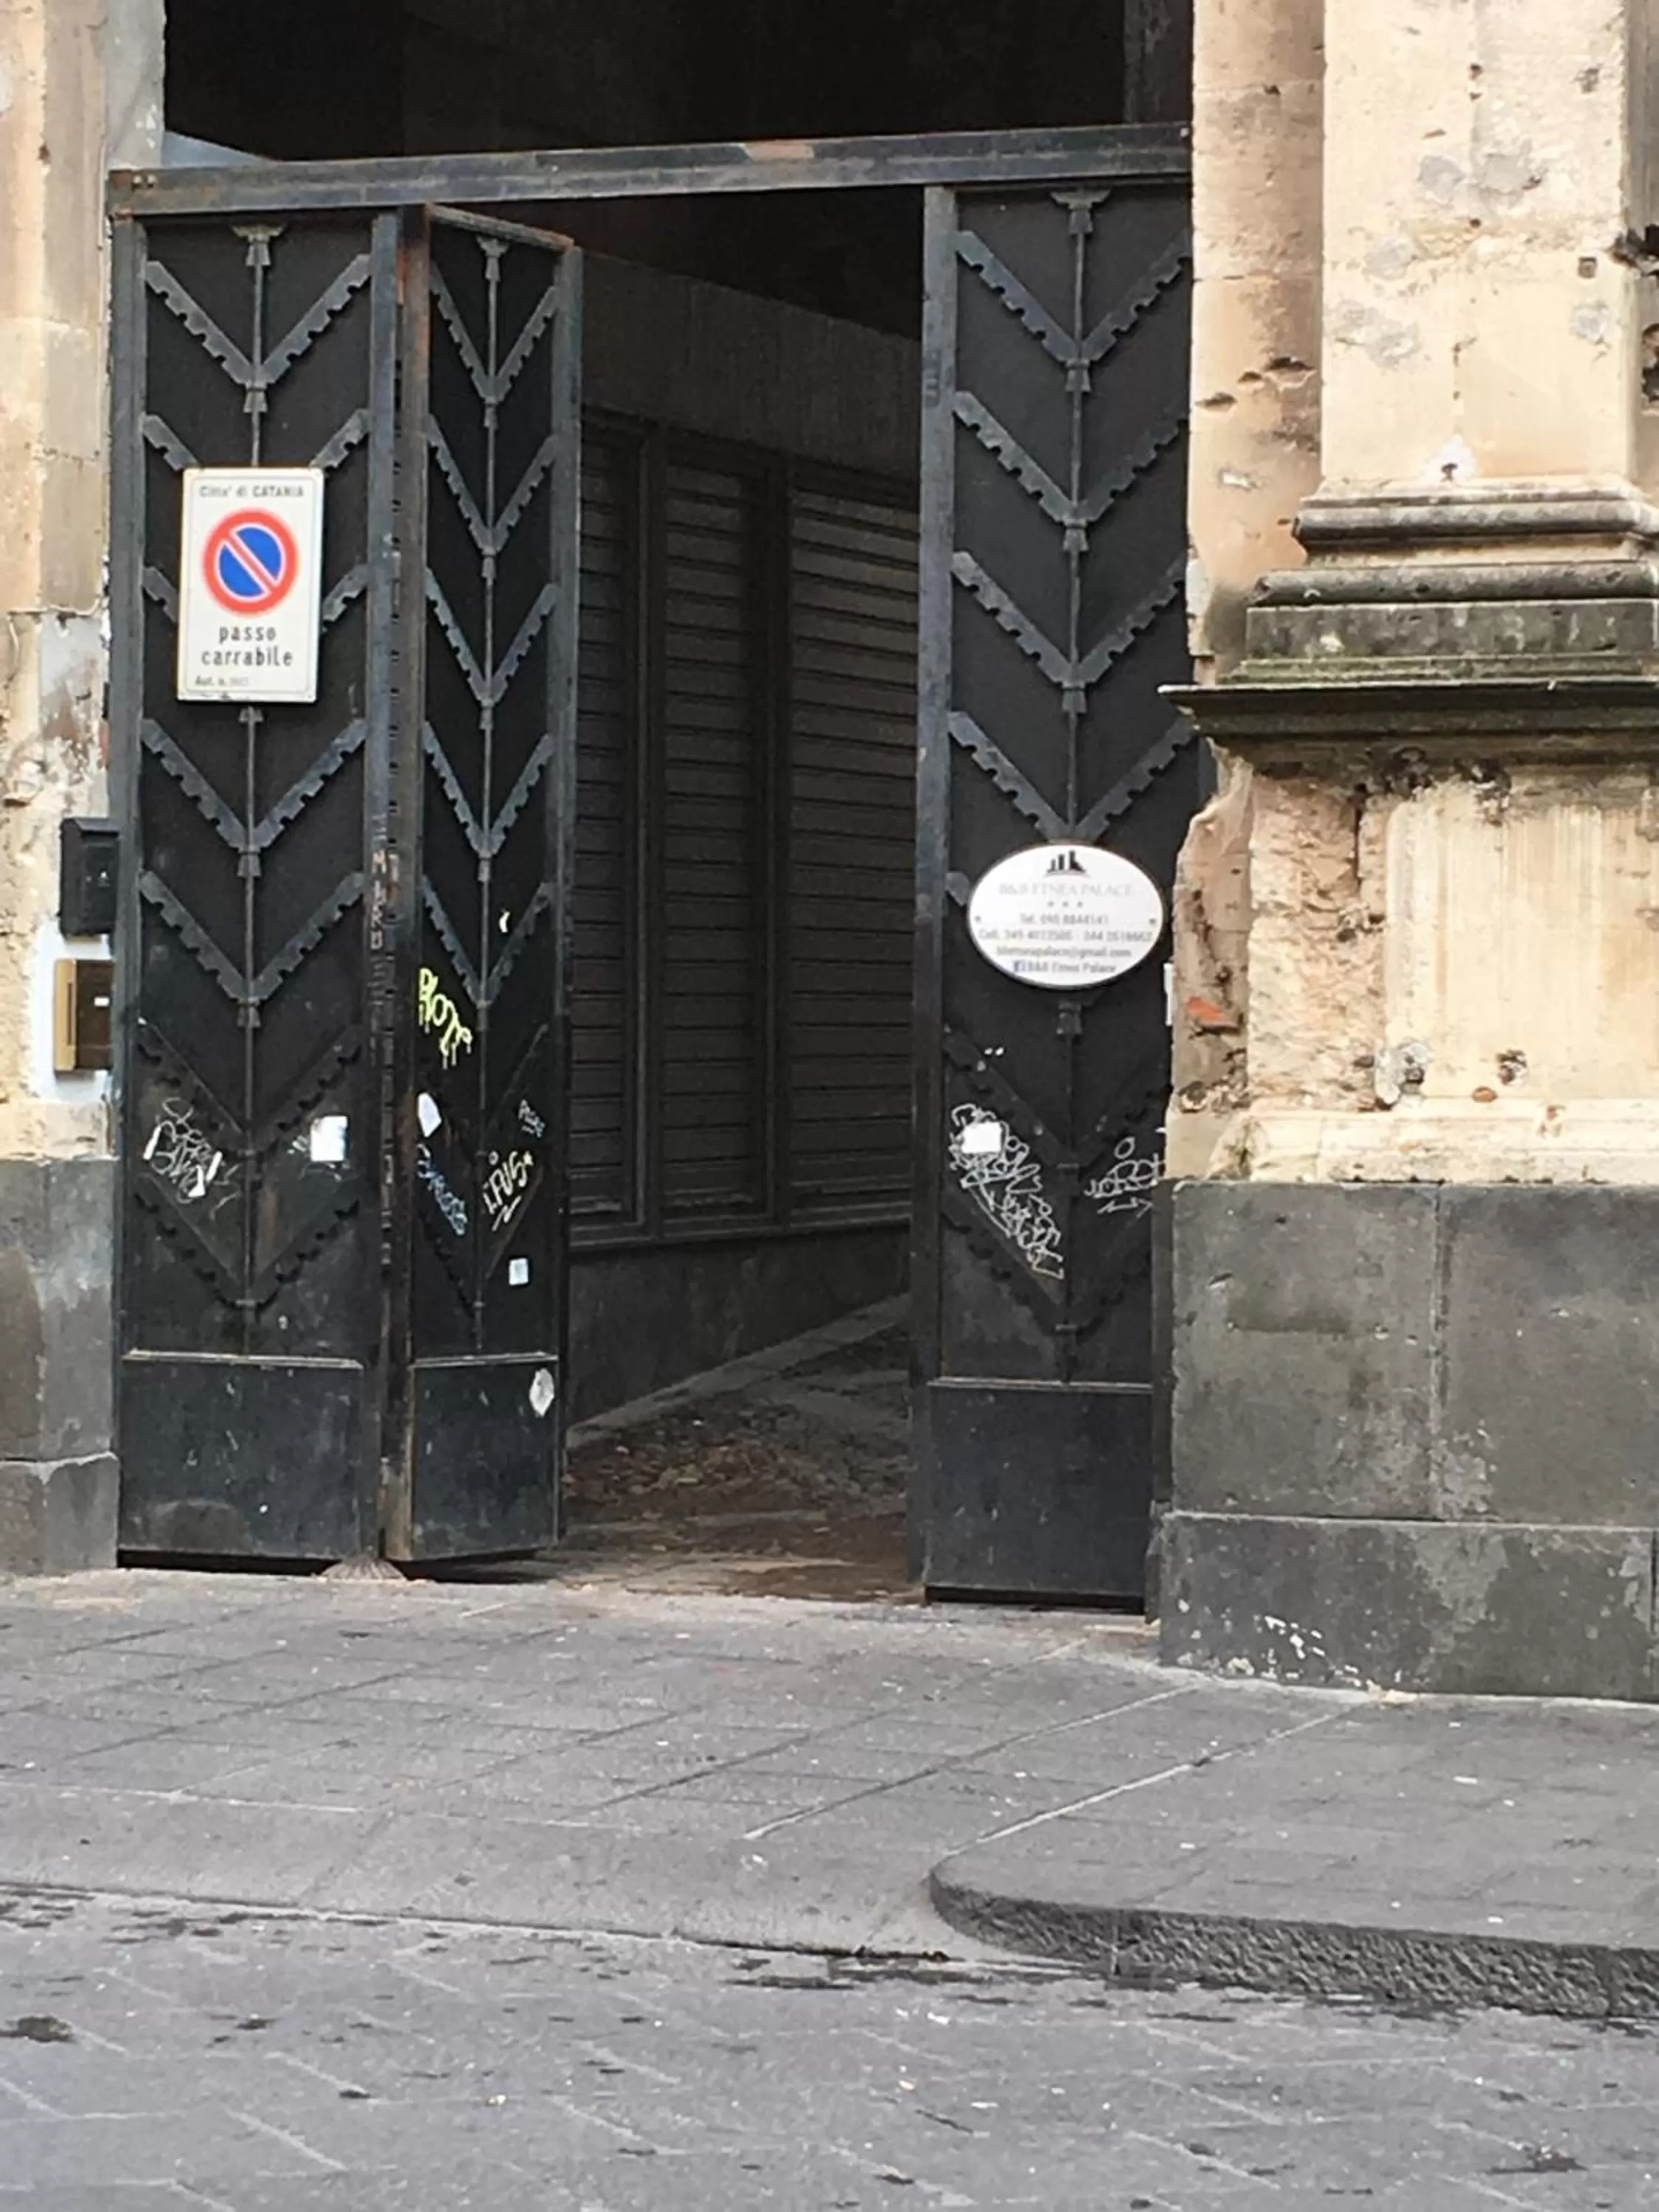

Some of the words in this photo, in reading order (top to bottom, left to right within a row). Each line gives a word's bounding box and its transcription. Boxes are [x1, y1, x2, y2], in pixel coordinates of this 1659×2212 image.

[236, 485, 248, 497] di
[252, 485, 305, 498] CATANIA
[219, 625, 277, 644] passo
[201, 646, 294, 667] carrabile
[1082, 885, 1133, 897] PALACE
[1082, 962, 1116, 973] Palace
